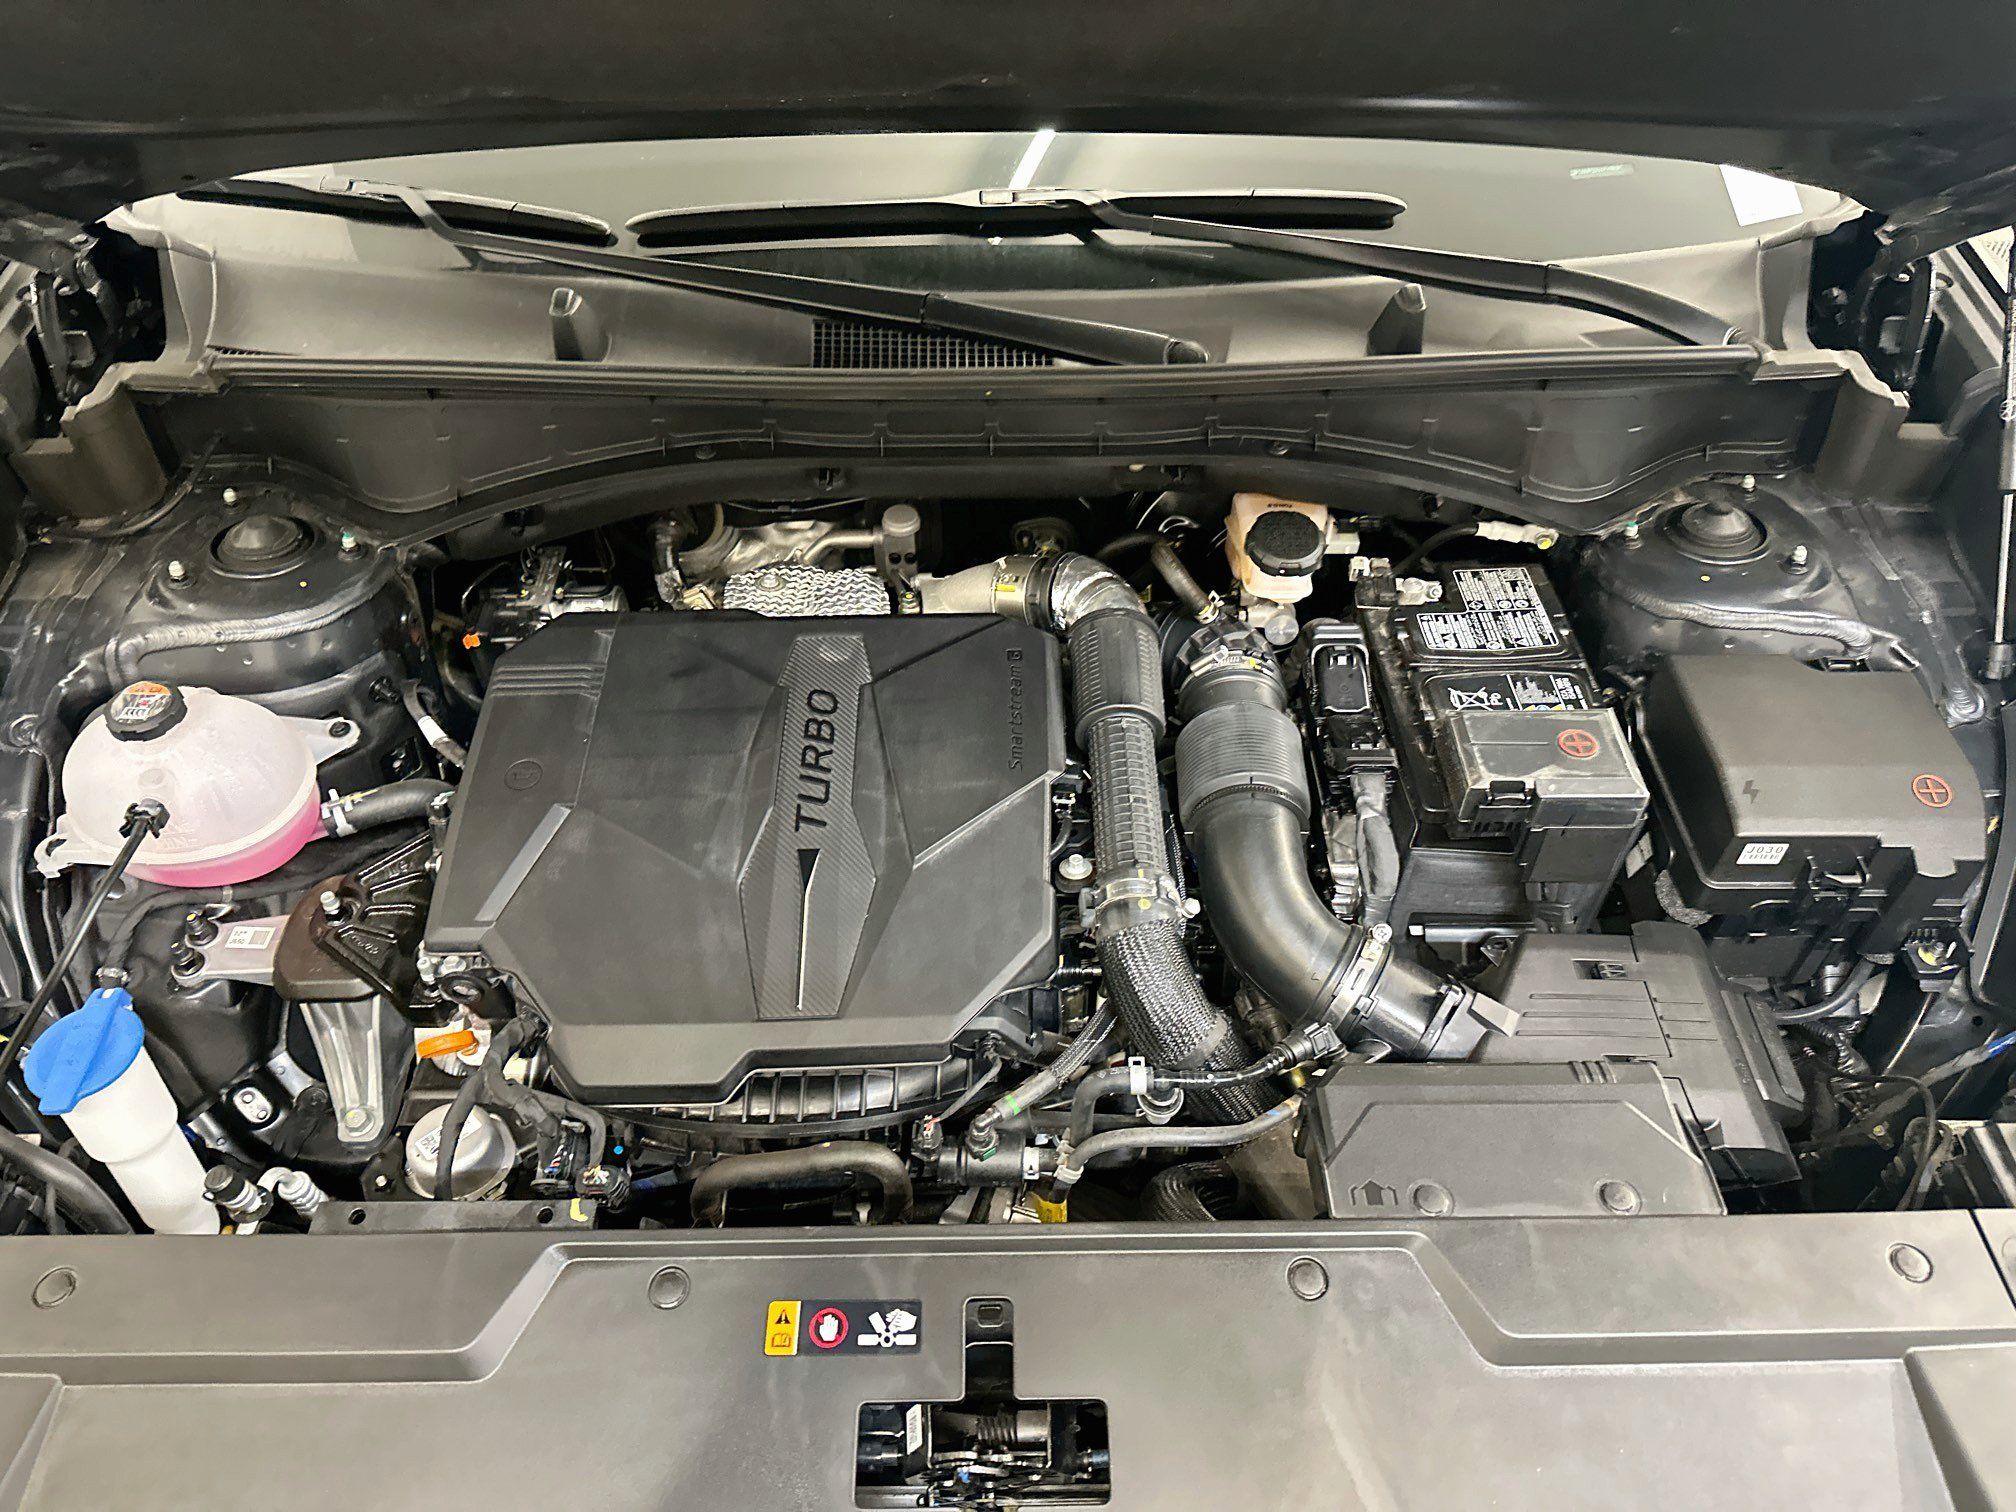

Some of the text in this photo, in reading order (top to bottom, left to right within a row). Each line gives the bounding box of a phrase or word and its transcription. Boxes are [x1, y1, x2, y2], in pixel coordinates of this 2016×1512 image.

[1006, 665, 1024, 772] Smartstream
[1489, 692, 1504, 706] Pb
[795, 688, 839, 832] TURBO
[1747, 846, 1784, 854] J030
